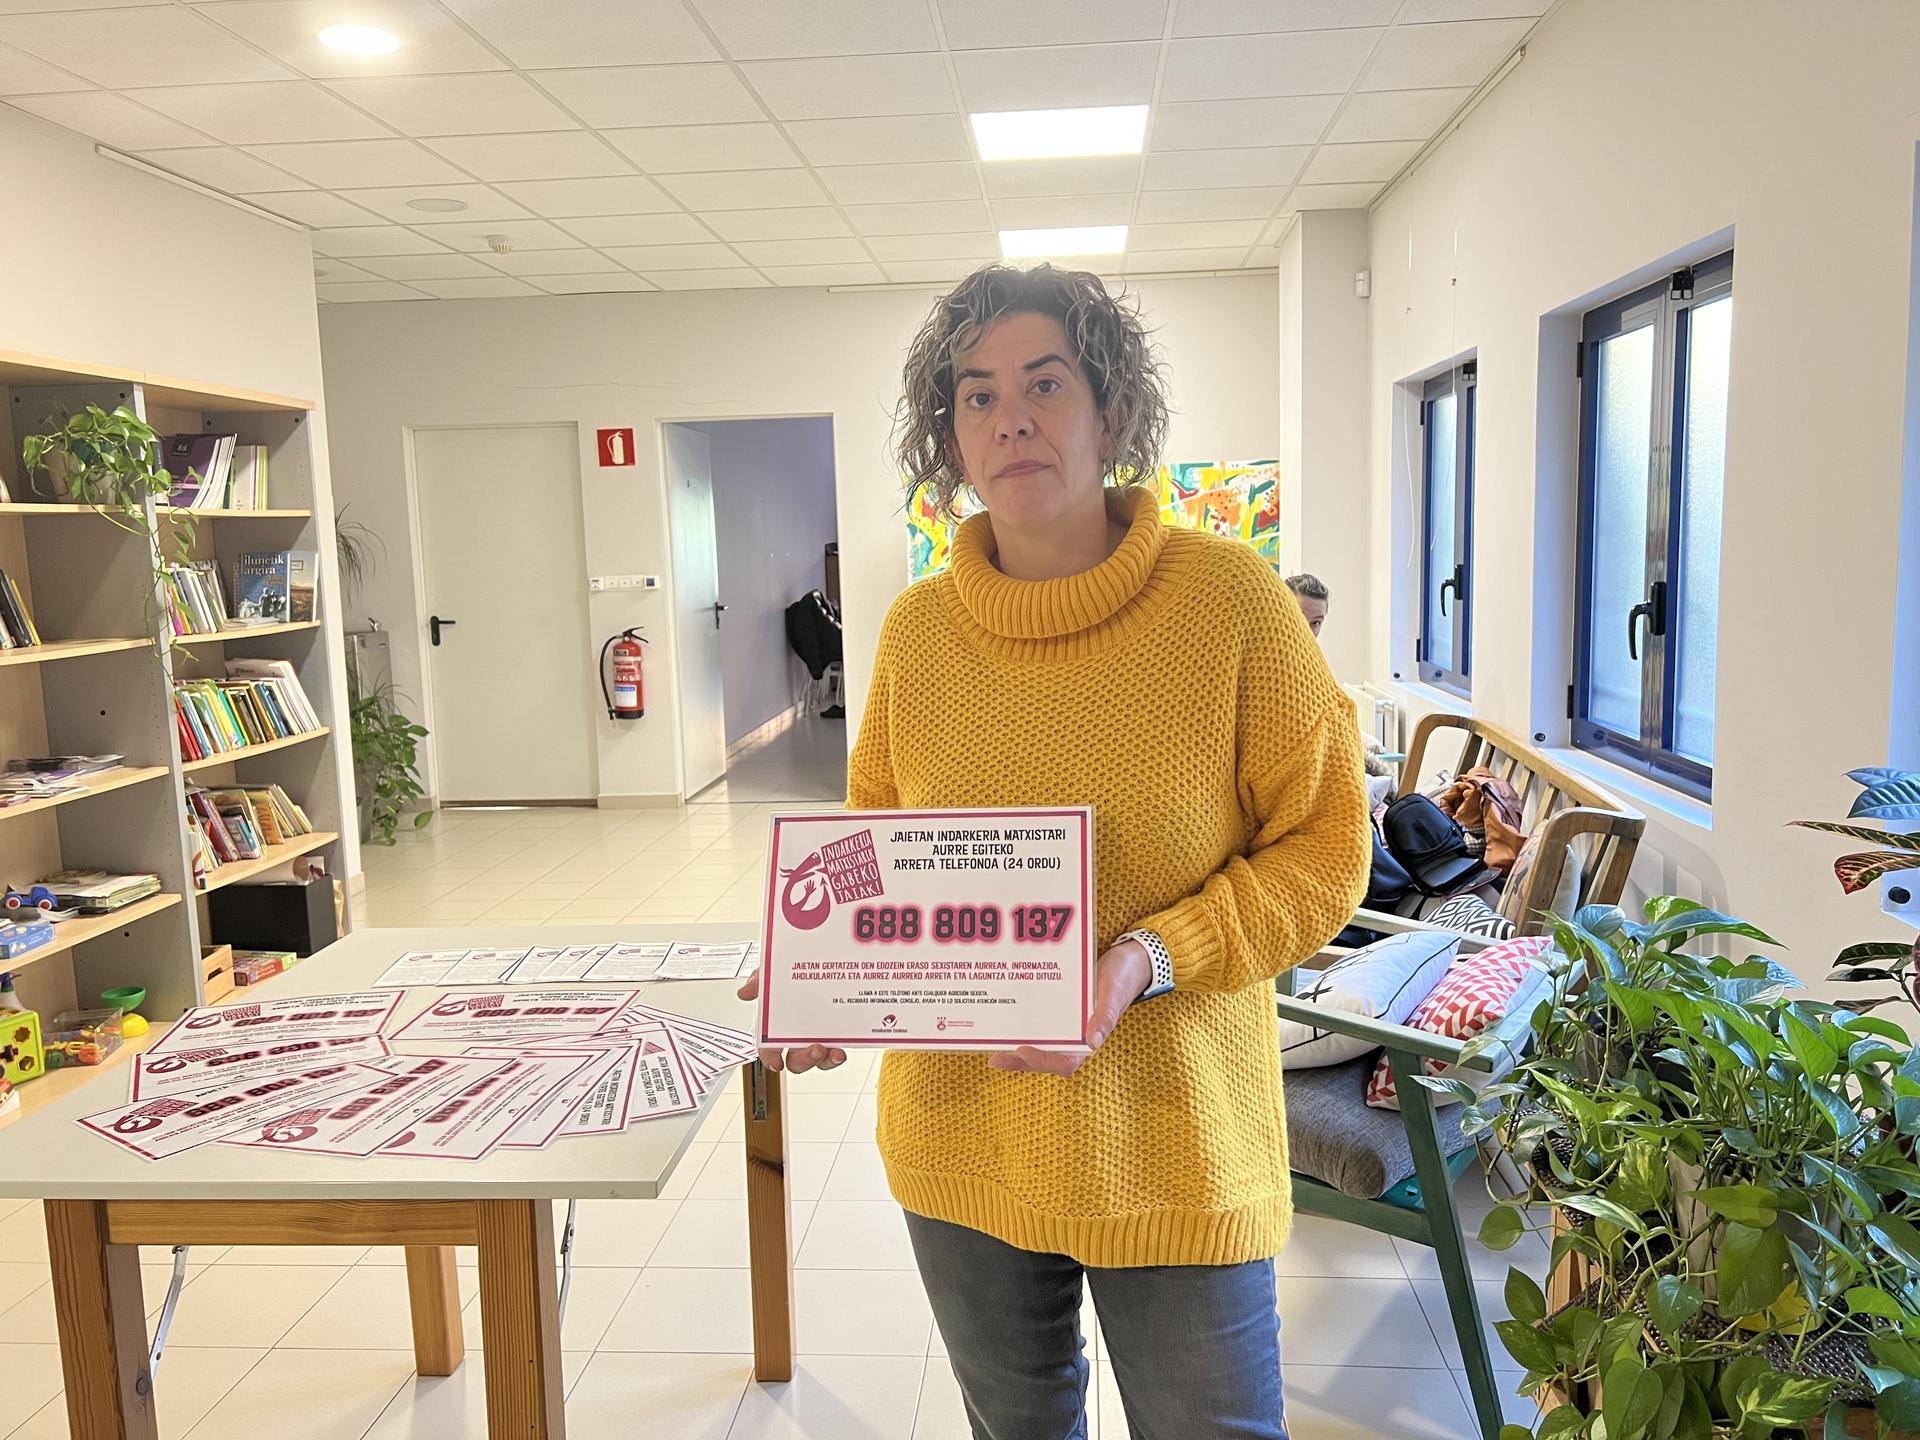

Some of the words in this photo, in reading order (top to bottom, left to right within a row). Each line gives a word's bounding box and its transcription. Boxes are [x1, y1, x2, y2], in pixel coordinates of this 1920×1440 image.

[244, 553, 284, 565] ilunetik
[243, 565, 277, 577] argira
[890, 831, 934, 842] JAIETAN
[937, 830, 1001, 841] INDARKERIA
[1004, 829, 1066, 840] MATXISTARI
[822, 831, 873, 862] INDARKERIA
[932, 844, 968, 855] AURRE
[972, 843, 1014, 854] EGITEKO
[826, 848, 876, 876] MATXISTARIK
[893, 859, 935, 870] ARRETA
[939, 858, 999, 869] TELEFONOA
[1003, 857, 1023, 870] (24
[1027, 857, 1061, 870] ORDU)
[831, 862, 879, 890] GABEKO
[837, 881, 882, 903] JAIAK!
[856, 907, 919, 939] 688
[935, 907, 1000, 938] 809
[1014, 907, 1072, 938] 137
[791, 961, 820, 970] JAIETAN
[822, 961, 859, 970] GERTATZEN
[861, 961, 875, 970] DEN
[876, 961, 905, 970] EDOZEIN
[906, 961, 929, 970] ERASO
[931, 961, 972, 970] SEXISTAREN
[791, 972, 846, 980] AHOLKULARITZA
[848, 972, 860, 980] ETA
[863, 972, 889, 980] AURREZ
[891, 972, 923, 980] AURREKO
[924, 972, 951, 980] ARRETA
[953, 972, 967, 980] ETA
[969, 972, 1006, 980] LAGUNTZA
[1008, 972, 1034, 980] IZANGO
